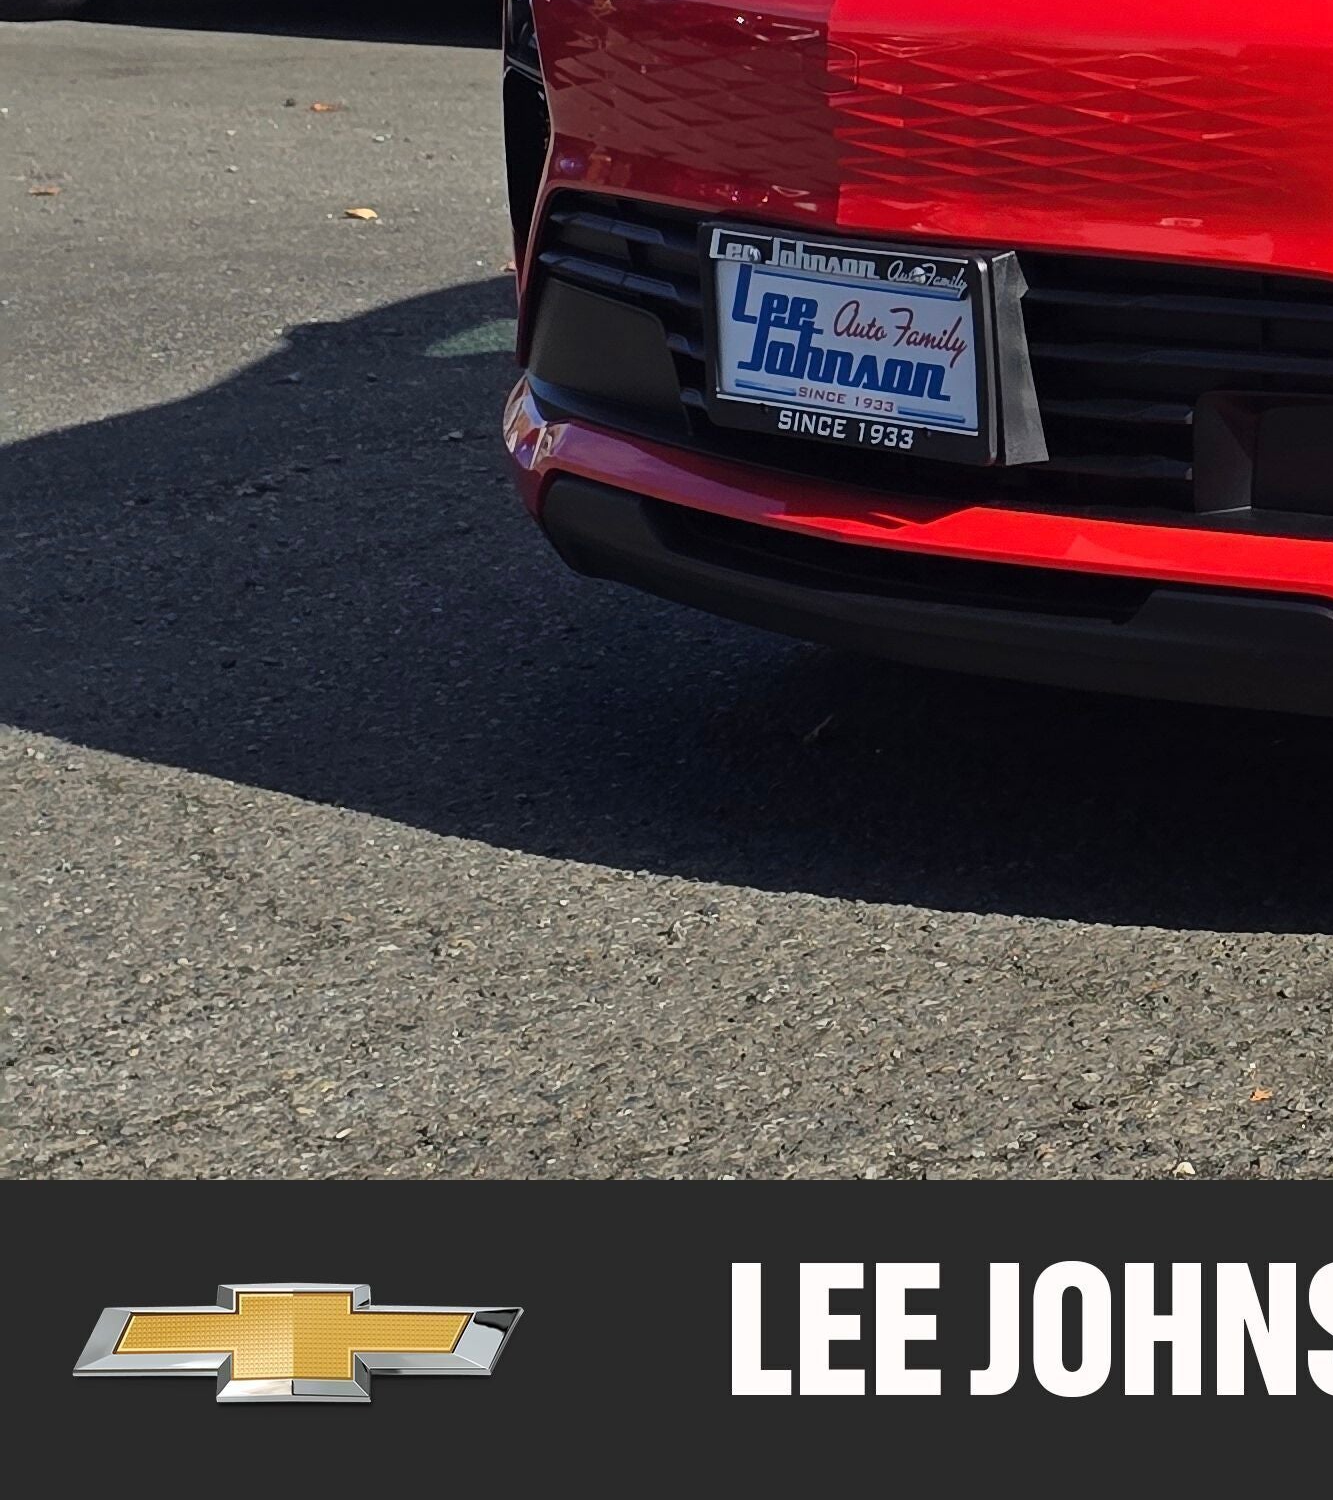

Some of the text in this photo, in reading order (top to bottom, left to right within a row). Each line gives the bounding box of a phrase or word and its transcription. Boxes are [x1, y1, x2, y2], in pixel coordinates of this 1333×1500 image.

[765, 237, 880, 280] Johnson
[921, 262, 968, 296] Family
[732, 263, 823, 334] Lee
[737, 318, 951, 402] Johnson
[833, 300, 967, 368] Auto Family
[778, 410, 914, 450] SINCE 1933
[798, 386, 894, 413] SINCE 1933
